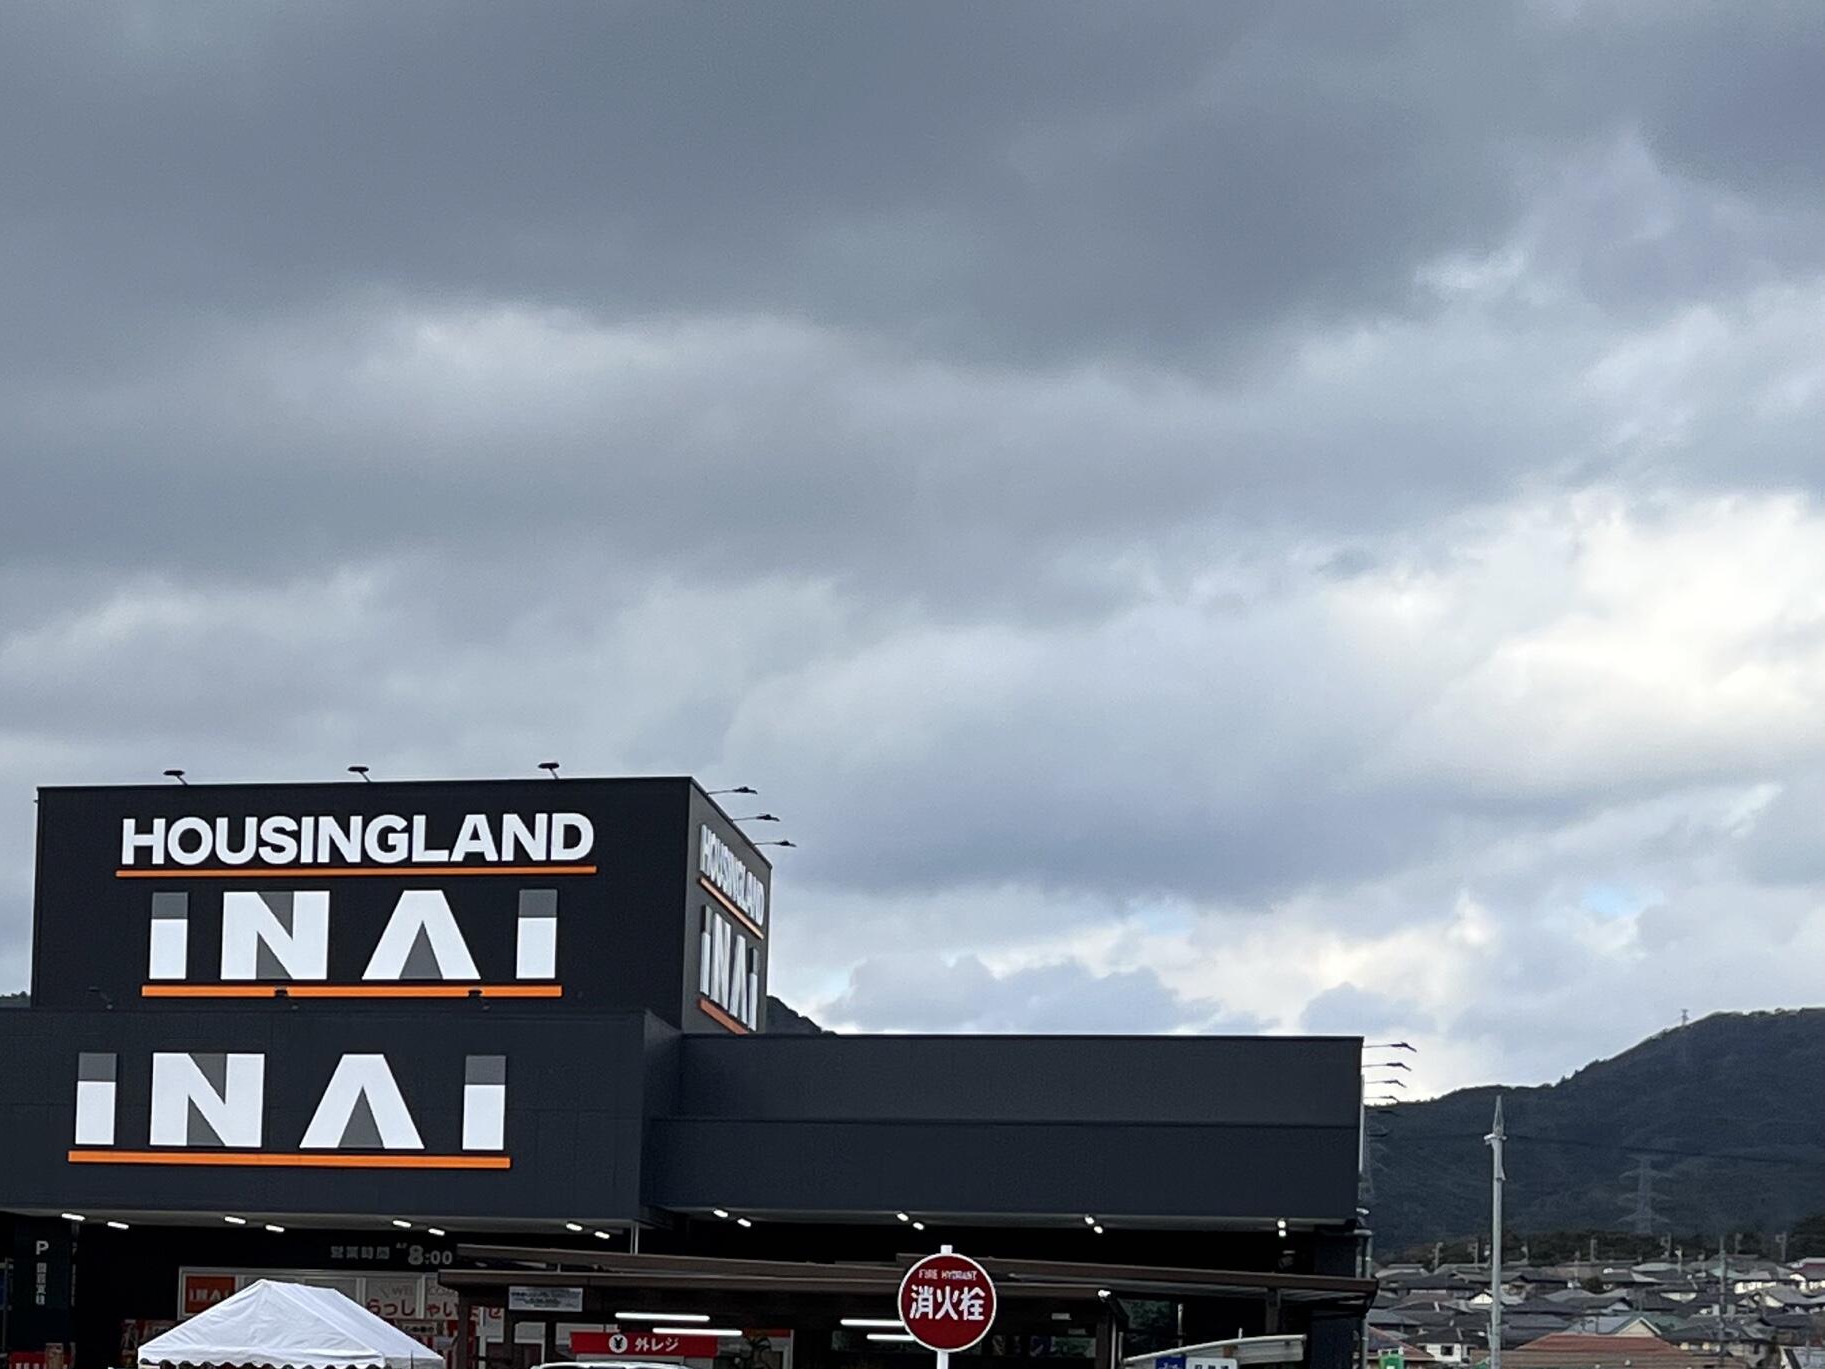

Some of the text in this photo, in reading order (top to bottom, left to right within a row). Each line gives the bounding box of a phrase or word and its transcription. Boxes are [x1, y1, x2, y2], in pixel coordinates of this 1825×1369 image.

[120, 812, 595, 866] HOUSINGLAND
[699, 823, 766, 927] HOUSINGLAND
[909, 1284, 986, 1321] 消火栓
[634, 1335, 680, 1353] 外レジ
